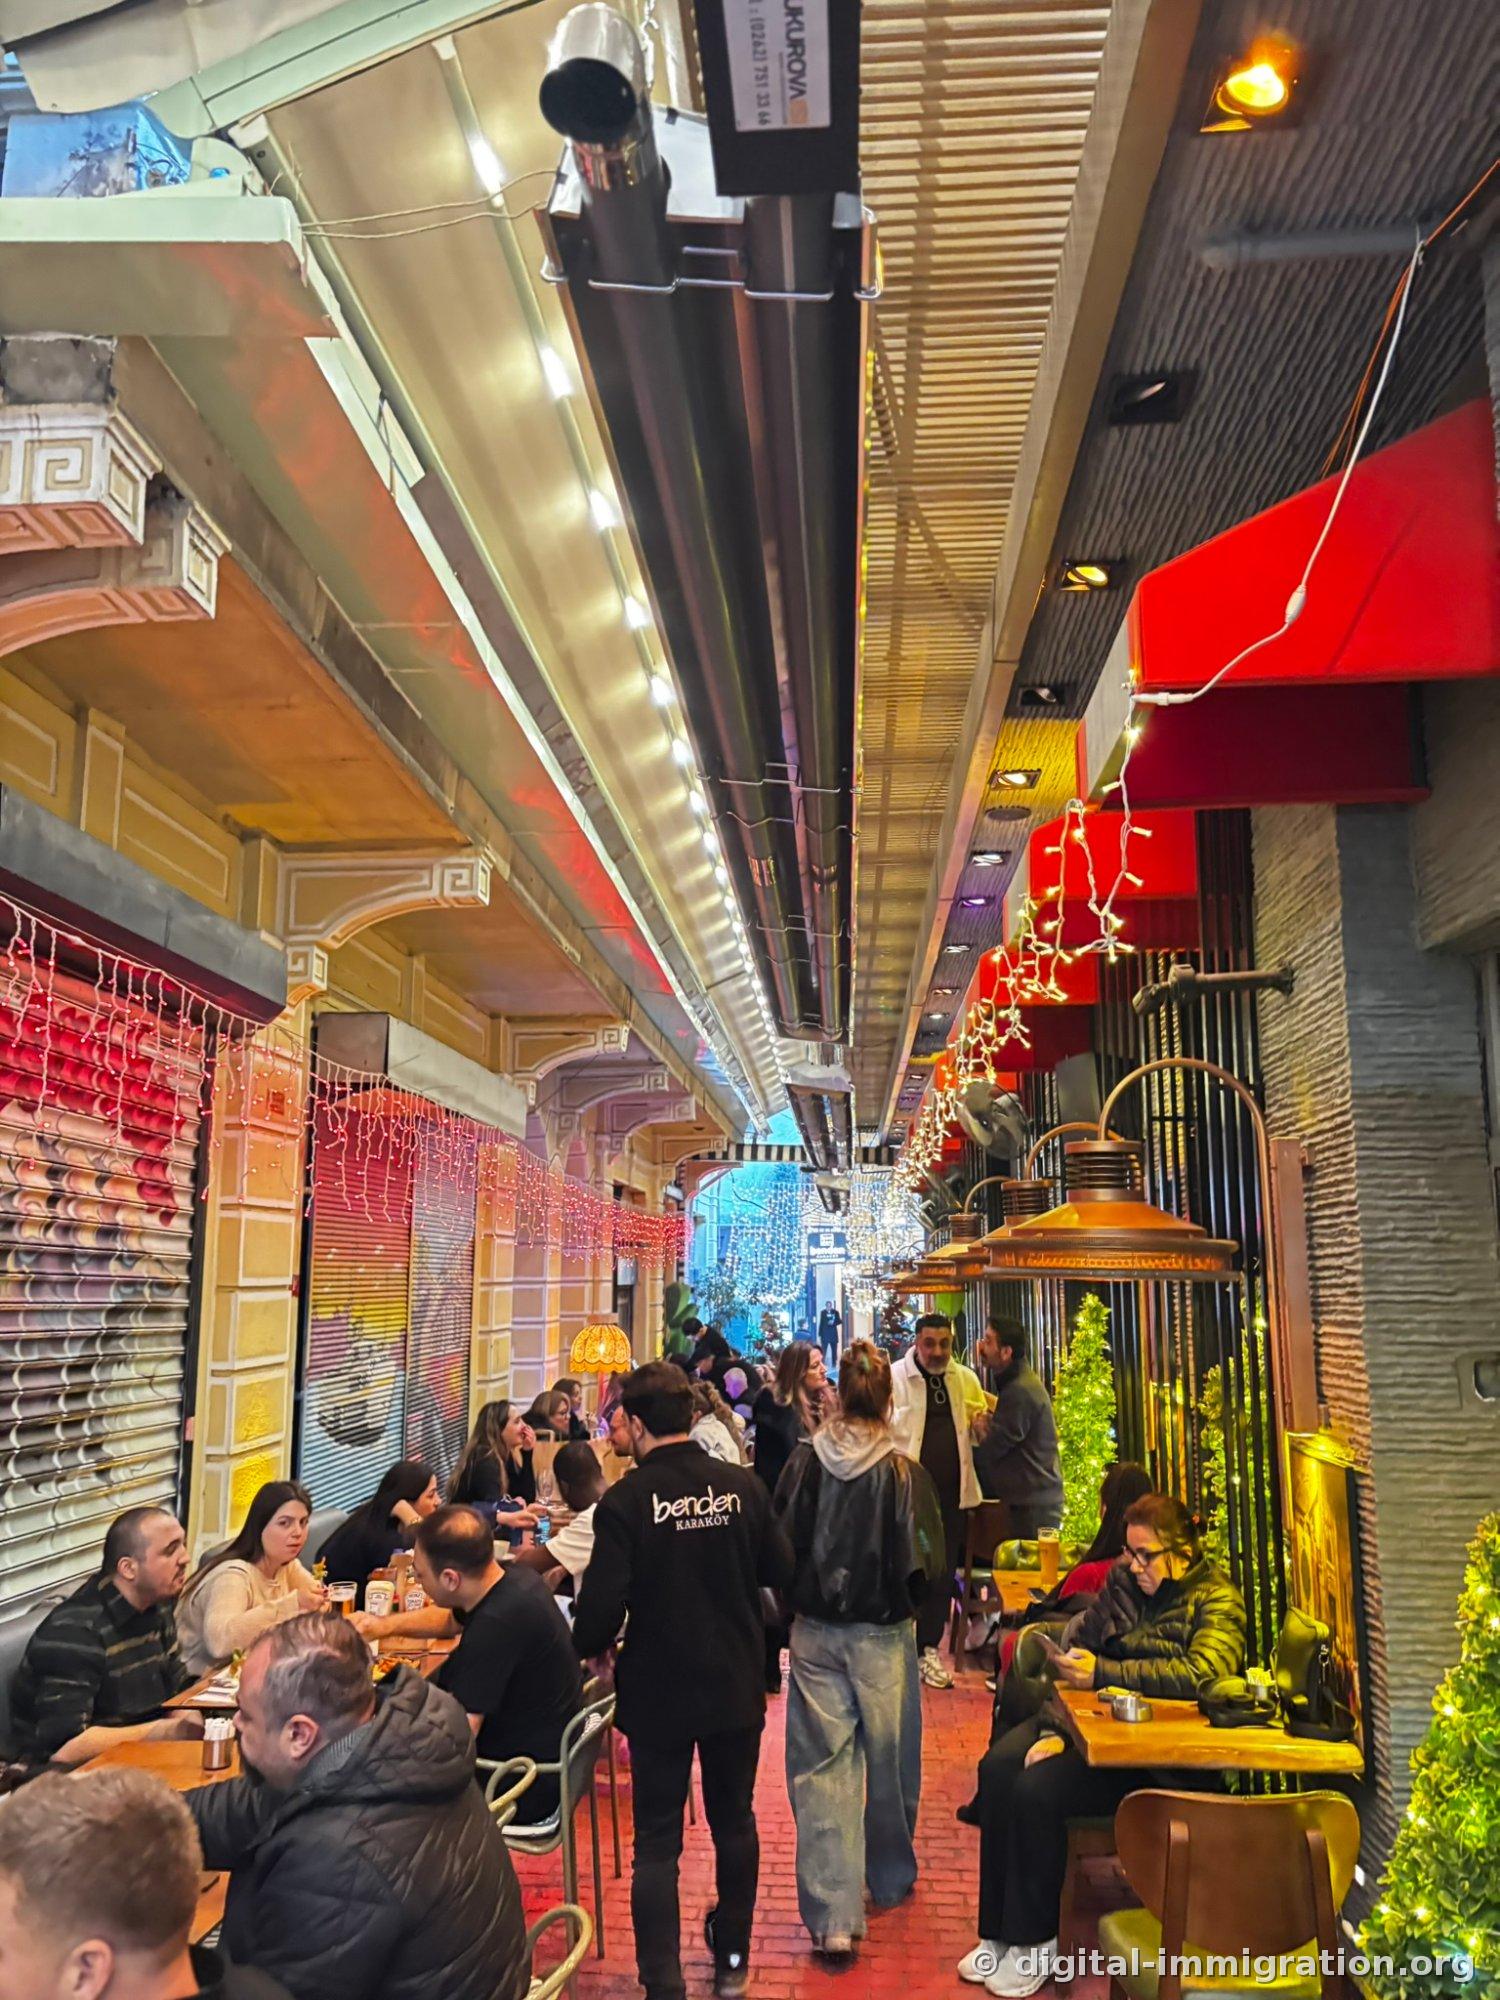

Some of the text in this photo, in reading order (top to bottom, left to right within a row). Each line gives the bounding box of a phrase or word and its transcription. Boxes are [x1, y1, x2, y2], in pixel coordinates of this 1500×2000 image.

[750, 17, 768, 62] (0262)
[754, 65, 769, 88] 751
[756, 92, 771, 108] 33
[758, 111, 771, 126] 66
[652, 1485, 741, 1524] benden
[676, 1514, 730, 1531] KARAKÖY
